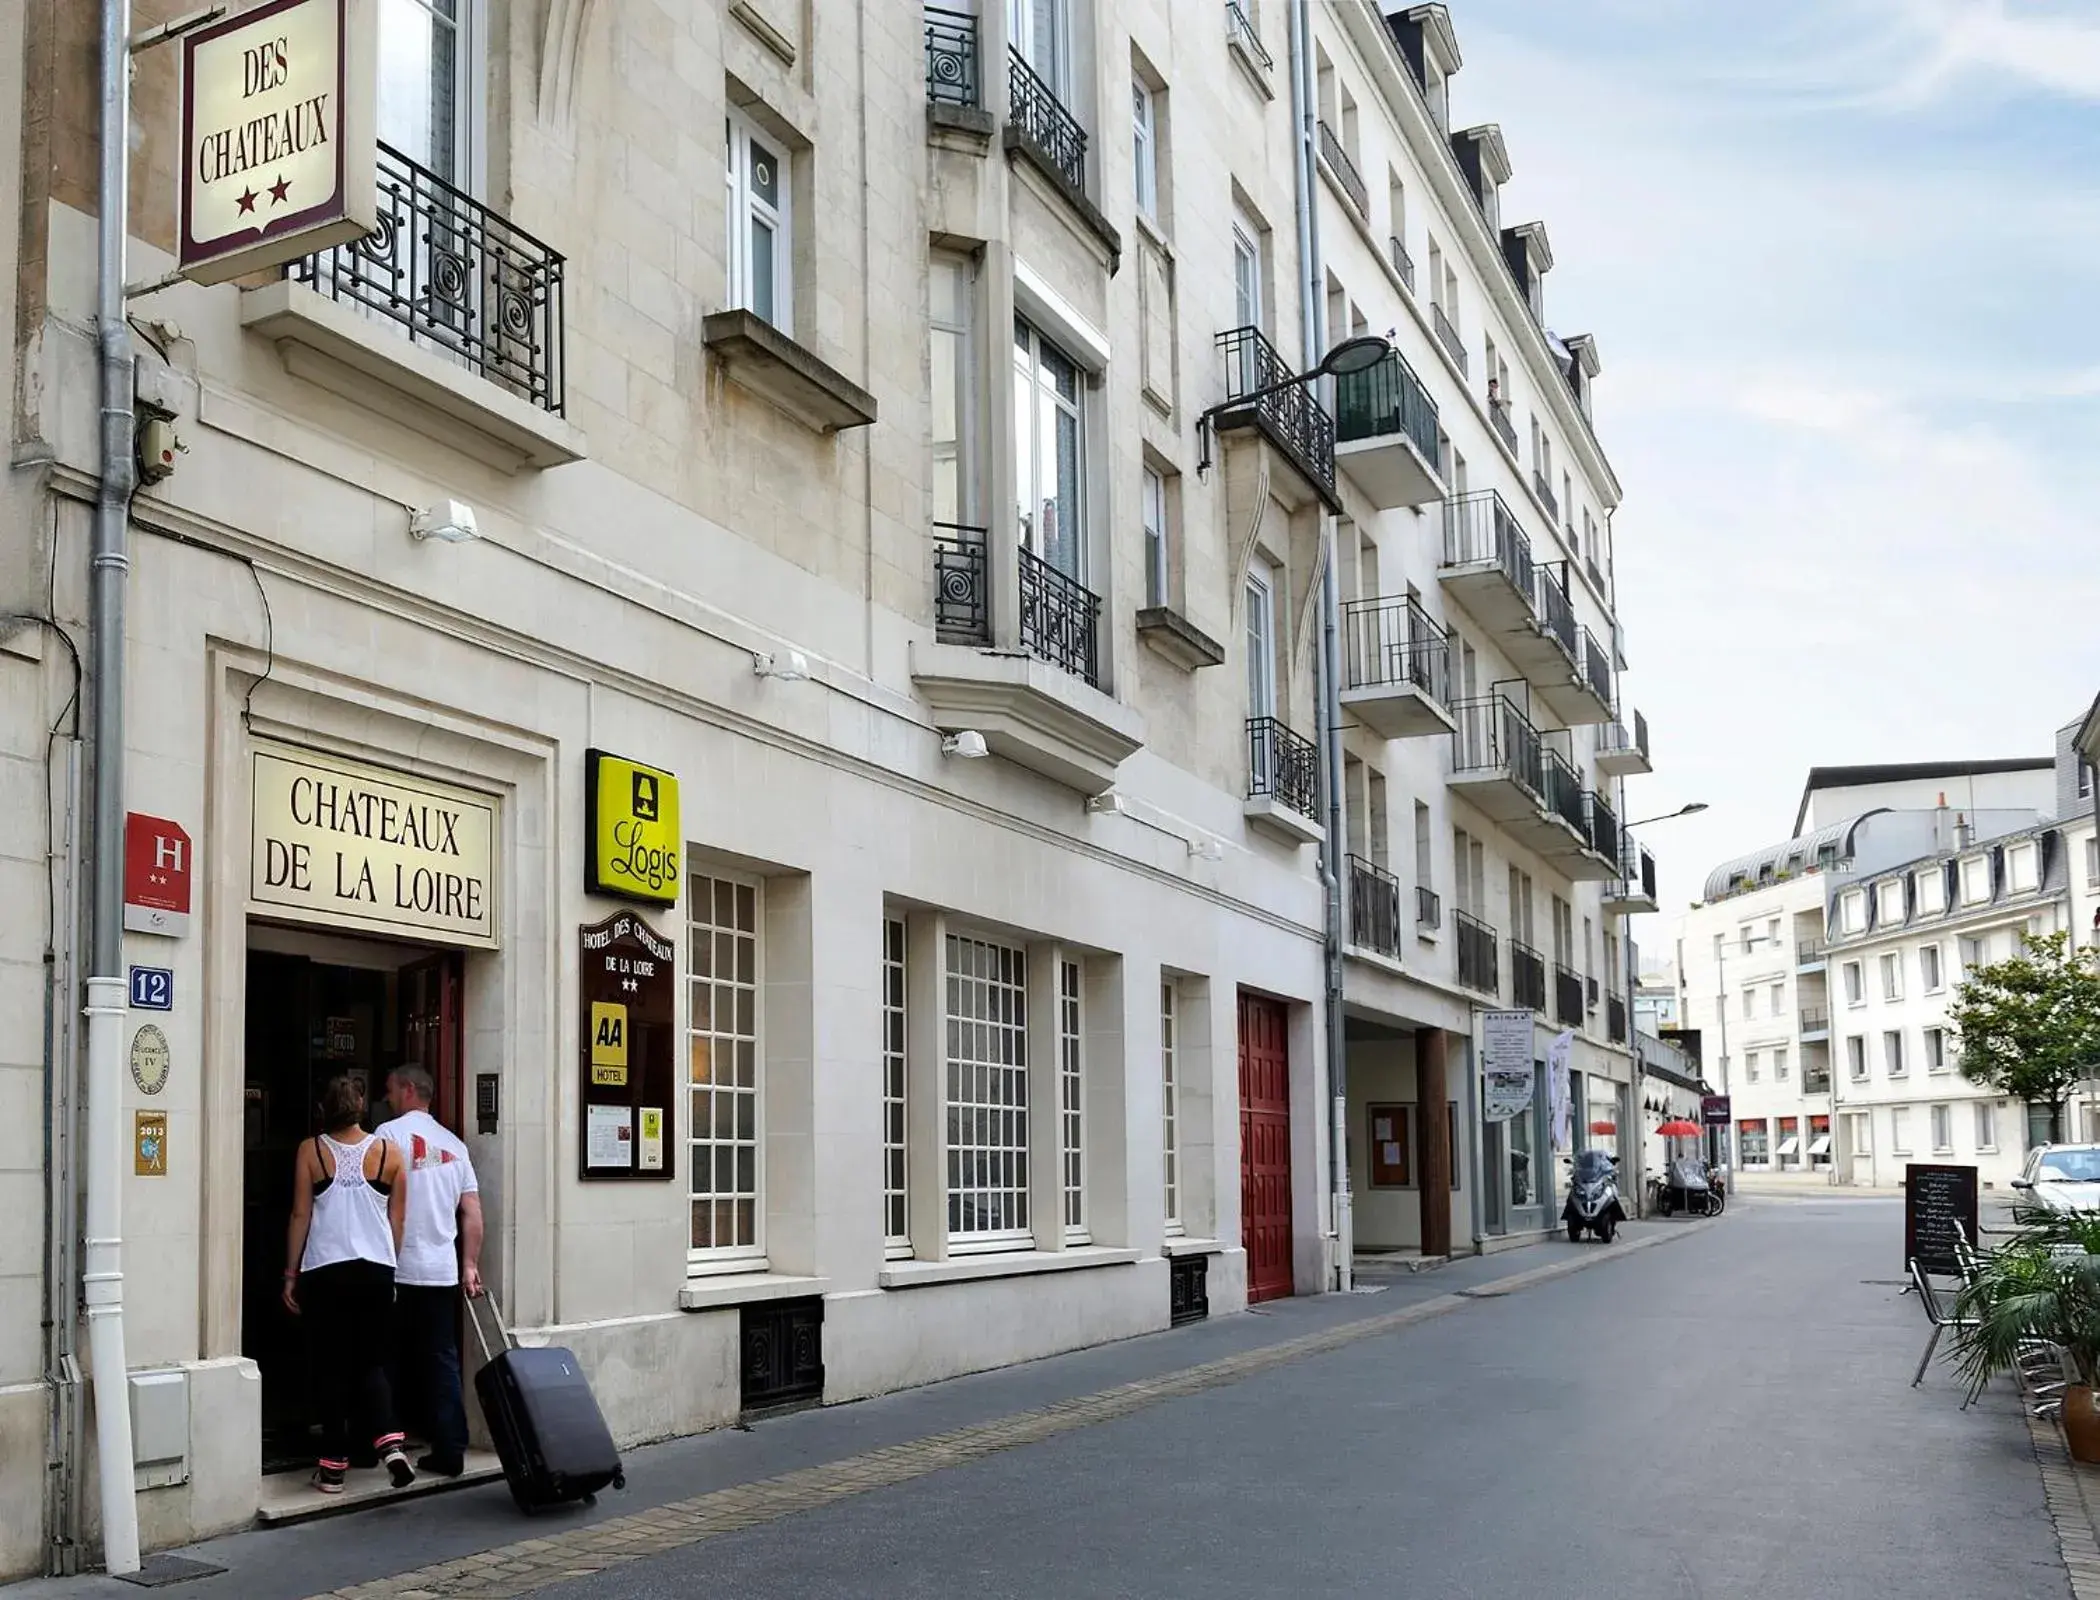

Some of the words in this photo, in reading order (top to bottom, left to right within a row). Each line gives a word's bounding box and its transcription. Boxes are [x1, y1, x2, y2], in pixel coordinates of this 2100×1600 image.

[242, 36, 289, 99] DES
[199, 93, 328, 184] CHATEAUX
[290, 776, 460, 856] CHATEAUX
[152, 835, 185, 873] H
[610, 820, 677, 890] Logis
[264, 838, 312, 892] DE
[335, 851, 377, 904] LA
[394, 863, 484, 921] LOIRE
[583, 930, 611, 949] HOTEL
[614, 918, 630, 939] DES
[633, 922, 673, 962] CHATEAUX
[605, 956, 617, 971] DE
[619, 958, 630, 973] LA
[633, 960, 655, 976] LOIRE
[138, 973, 166, 1003] 12
[596, 1017, 622, 1047] AA
[597, 1068, 622, 1082] HOTEL
[139, 1127, 164, 1136] 2013
